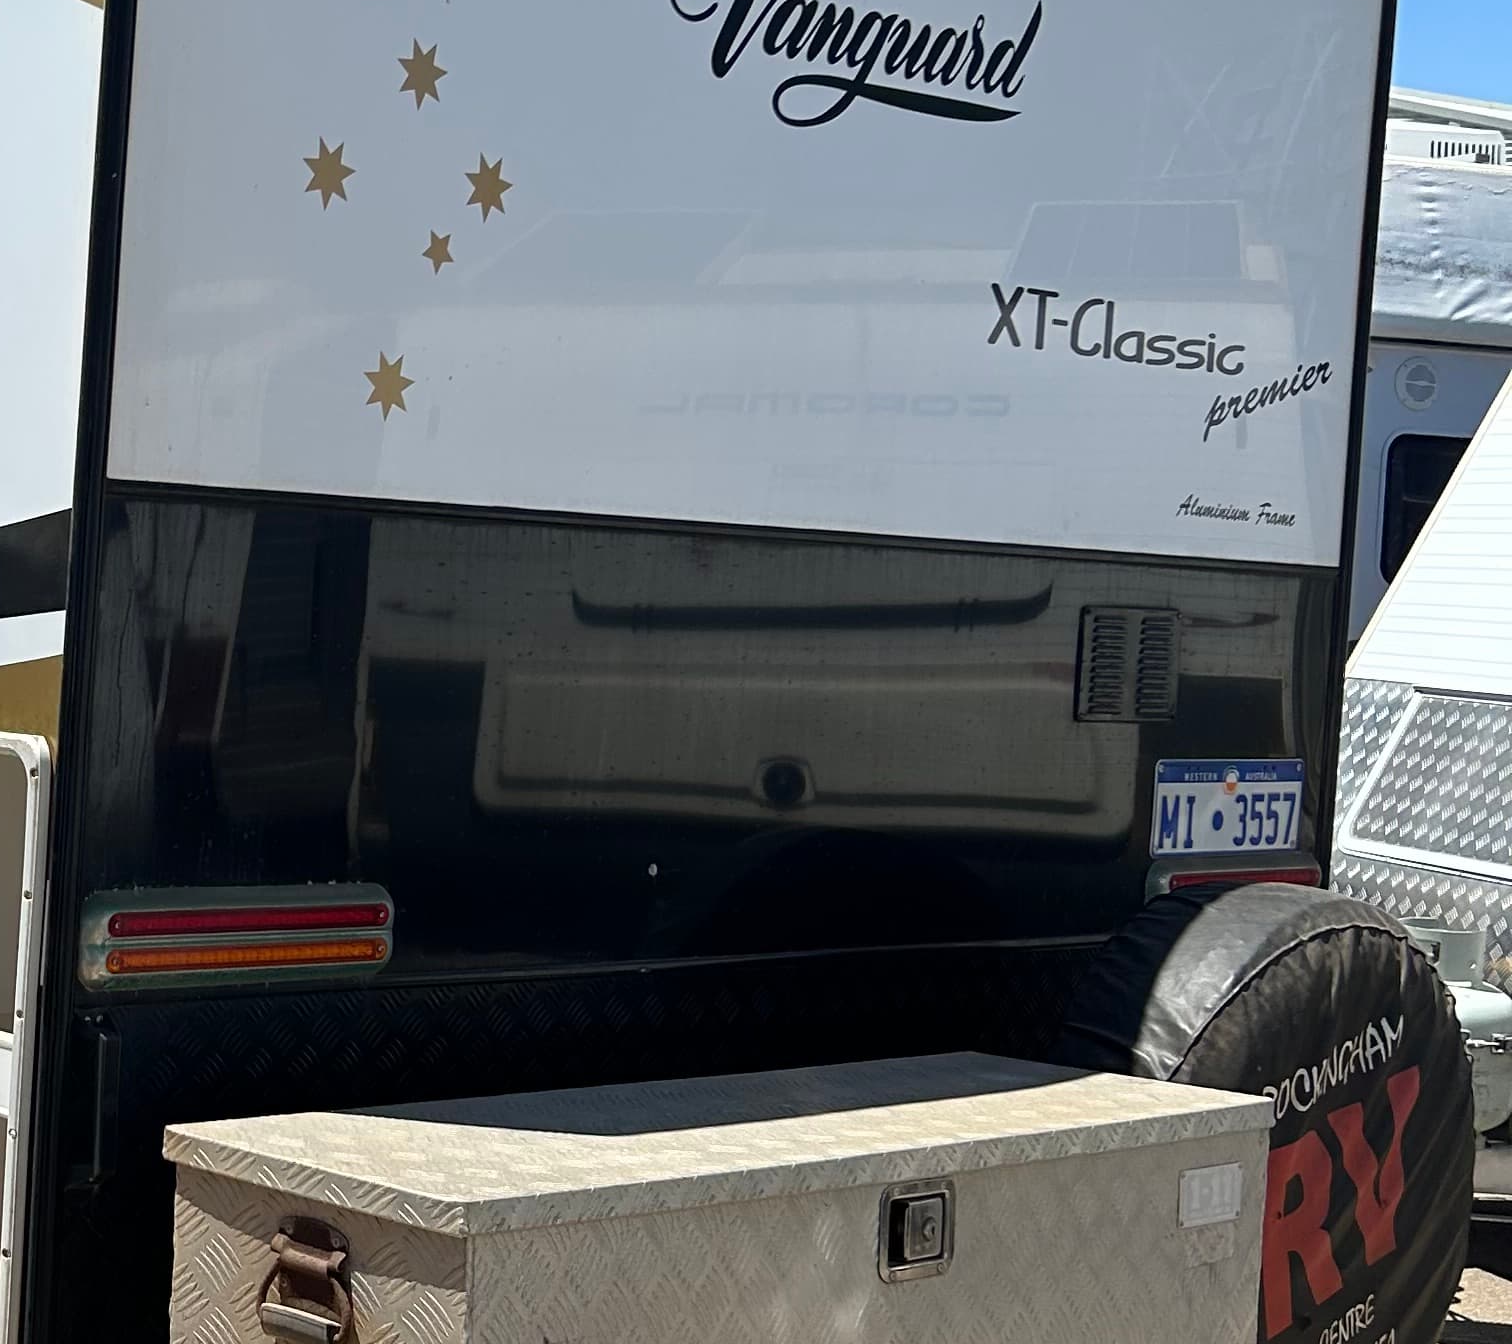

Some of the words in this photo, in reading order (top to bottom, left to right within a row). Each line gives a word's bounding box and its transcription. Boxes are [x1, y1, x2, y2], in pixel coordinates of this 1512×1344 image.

[987, 282, 1246, 376] XT-Classic
[1202, 360, 1333, 443] premier
[1175, 493, 1250, 522] Aluminium
[1255, 502, 1296, 528] Frame
[1183, 771, 1218, 782] WESTERN
[1244, 771, 1278, 782] AUSTRALIA
[1157, 794, 1197, 849] MI
[1232, 791, 1297, 847] 3557
[1260, 1064, 1421, 1341] RV
